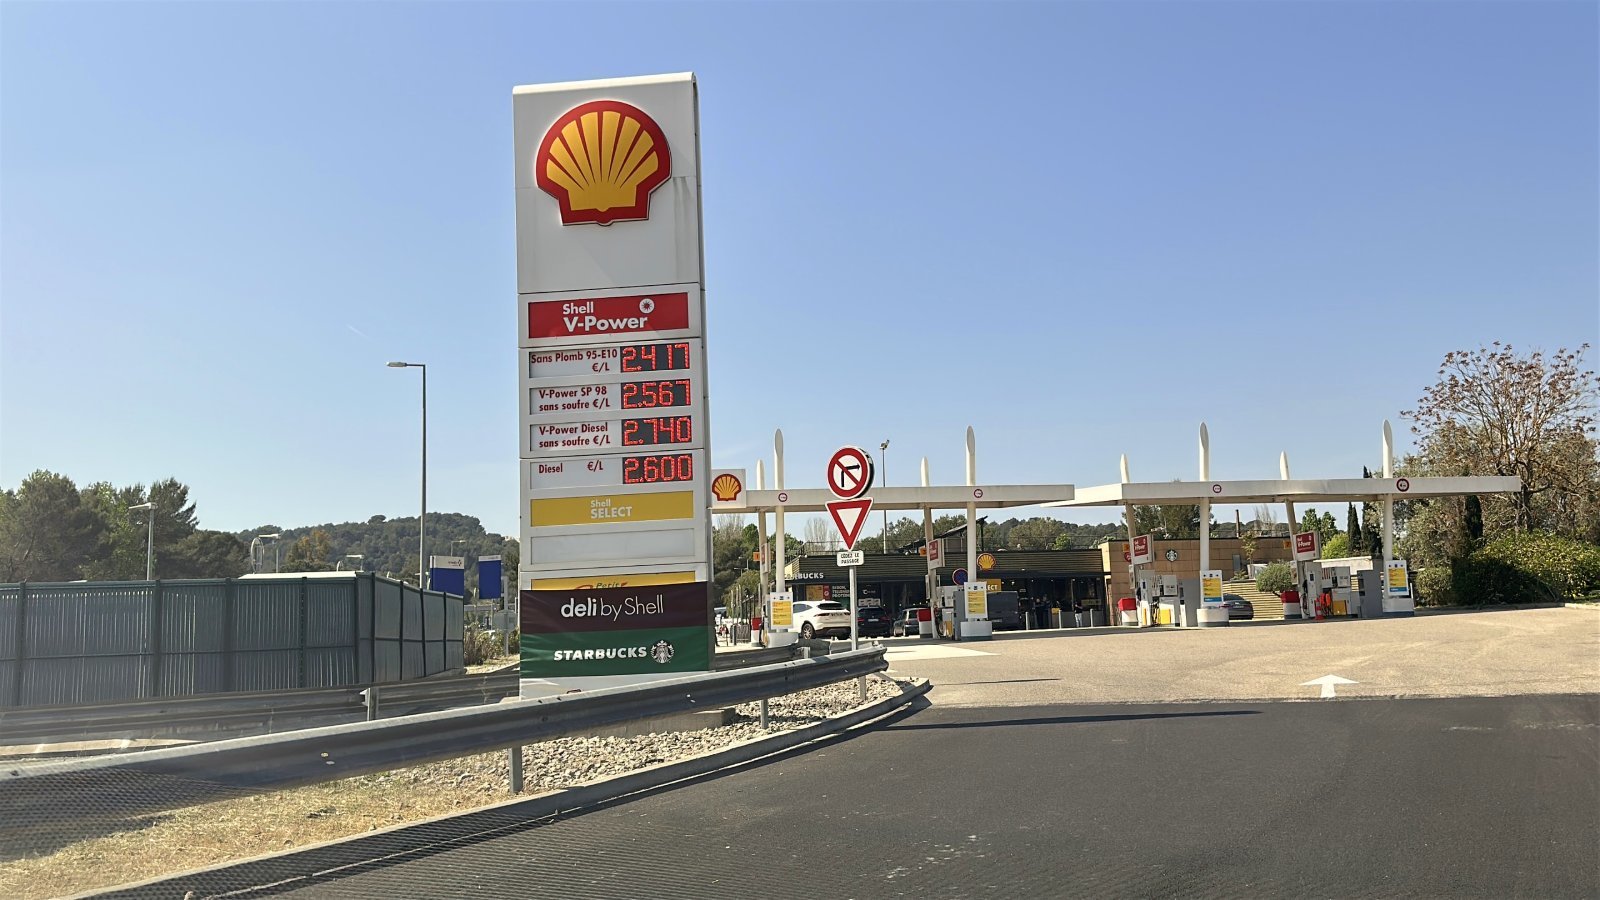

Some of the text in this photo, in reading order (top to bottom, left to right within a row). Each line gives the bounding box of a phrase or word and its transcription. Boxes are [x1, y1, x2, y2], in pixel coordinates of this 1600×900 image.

[562, 301, 594, 315] Shell
[563, 316, 648, 332] V-Power
[531, 349, 618, 364] Sans Plomb 95-E10
[622, 343, 689, 372] 2.417
[592, 362, 610, 373] €/L
[539, 385, 607, 399] V-Power SP 98
[623, 379, 691, 408] 2.567
[539, 398, 610, 412] sans soufre €/L
[539, 421, 608, 436] V-Power Diesel
[623, 416, 692, 446] 2.740
[539, 434, 611, 448] sans soufre €/L
[538, 459, 604, 474] Diesel €/L
[624, 454, 693, 484] 2.600
[590, 498, 611, 508] Shell
[590, 506, 633, 519] SELECT
[560, 594, 664, 622] deli by Shell
[553, 646, 647, 661] STARBUCKS
